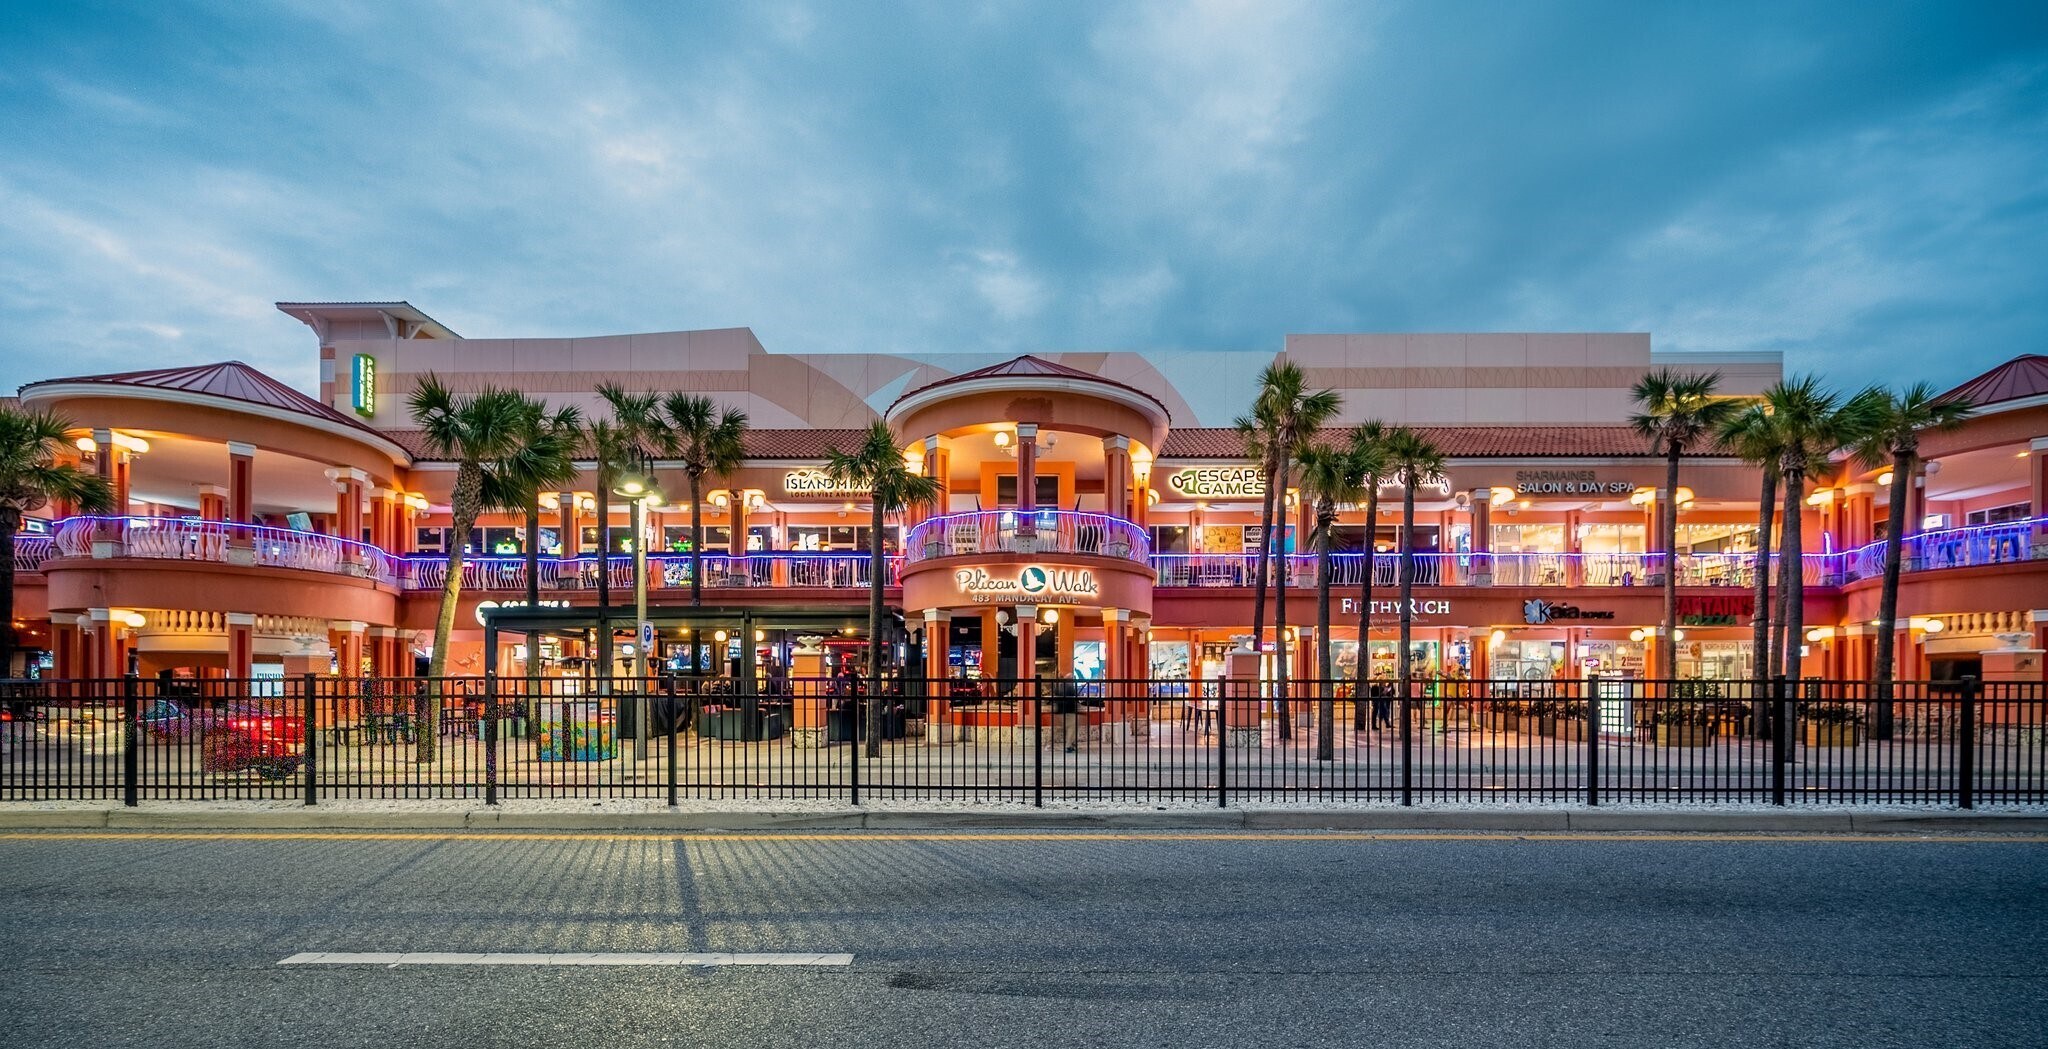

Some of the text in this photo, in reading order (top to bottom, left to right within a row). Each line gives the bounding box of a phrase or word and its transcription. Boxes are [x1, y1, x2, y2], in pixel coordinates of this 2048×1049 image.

[366, 358, 374, 413] PARKING
[1198, 469, 1266, 482] ESCAPE
[1516, 470, 1595, 481] SHARMAINES
[1197, 483, 1266, 495] GAMES
[1517, 481, 1636, 494] SALON & DAY SPA
[956, 569, 1098, 594] Pelican Walk
[972, 595, 1081, 604] 483 MANDALAY AVE.
[1538, 602, 1580, 623] Kaia
